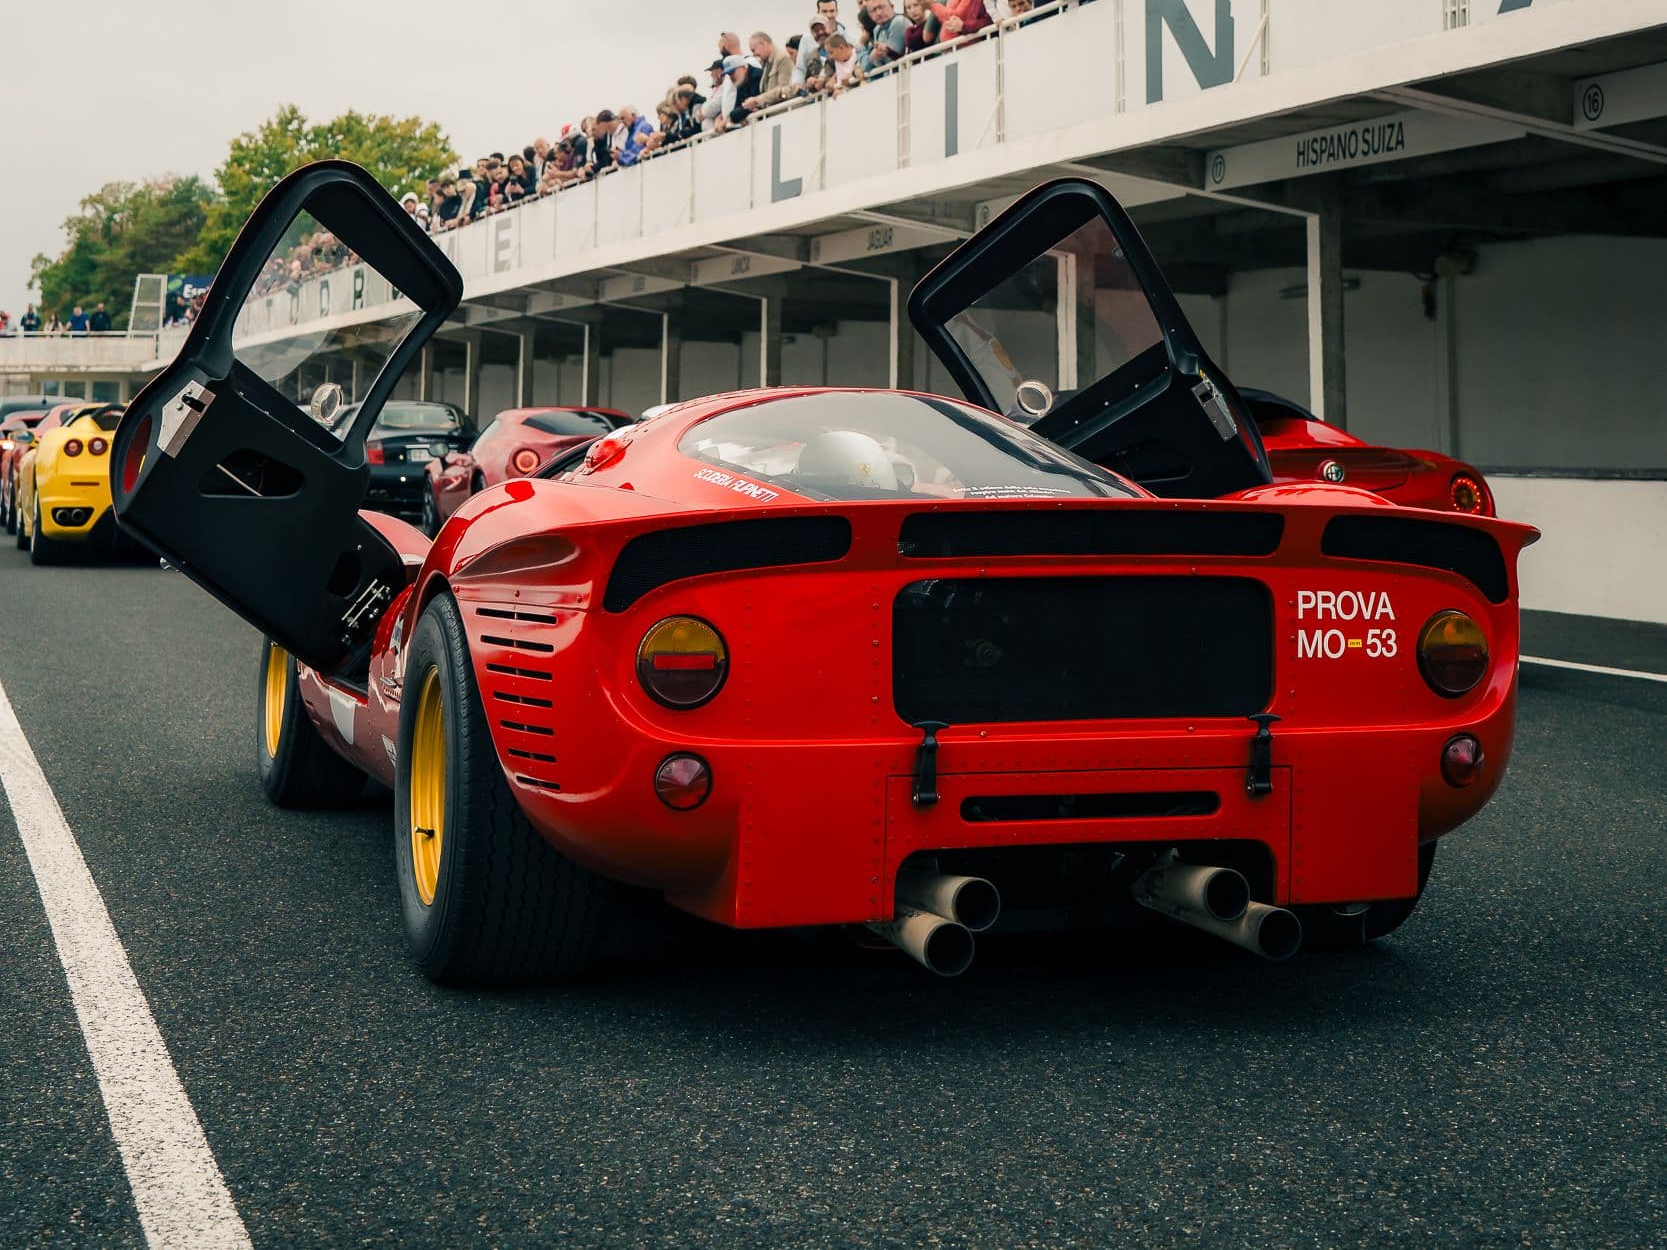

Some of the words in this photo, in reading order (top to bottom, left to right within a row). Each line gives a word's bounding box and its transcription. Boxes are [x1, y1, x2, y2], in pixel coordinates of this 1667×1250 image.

[1587, 91, 1599, 114] 16
[1296, 130, 1358, 168] HISPANO
[1361, 121, 1405, 157] SUIZA
[1297, 590, 1396, 621] PROVA
